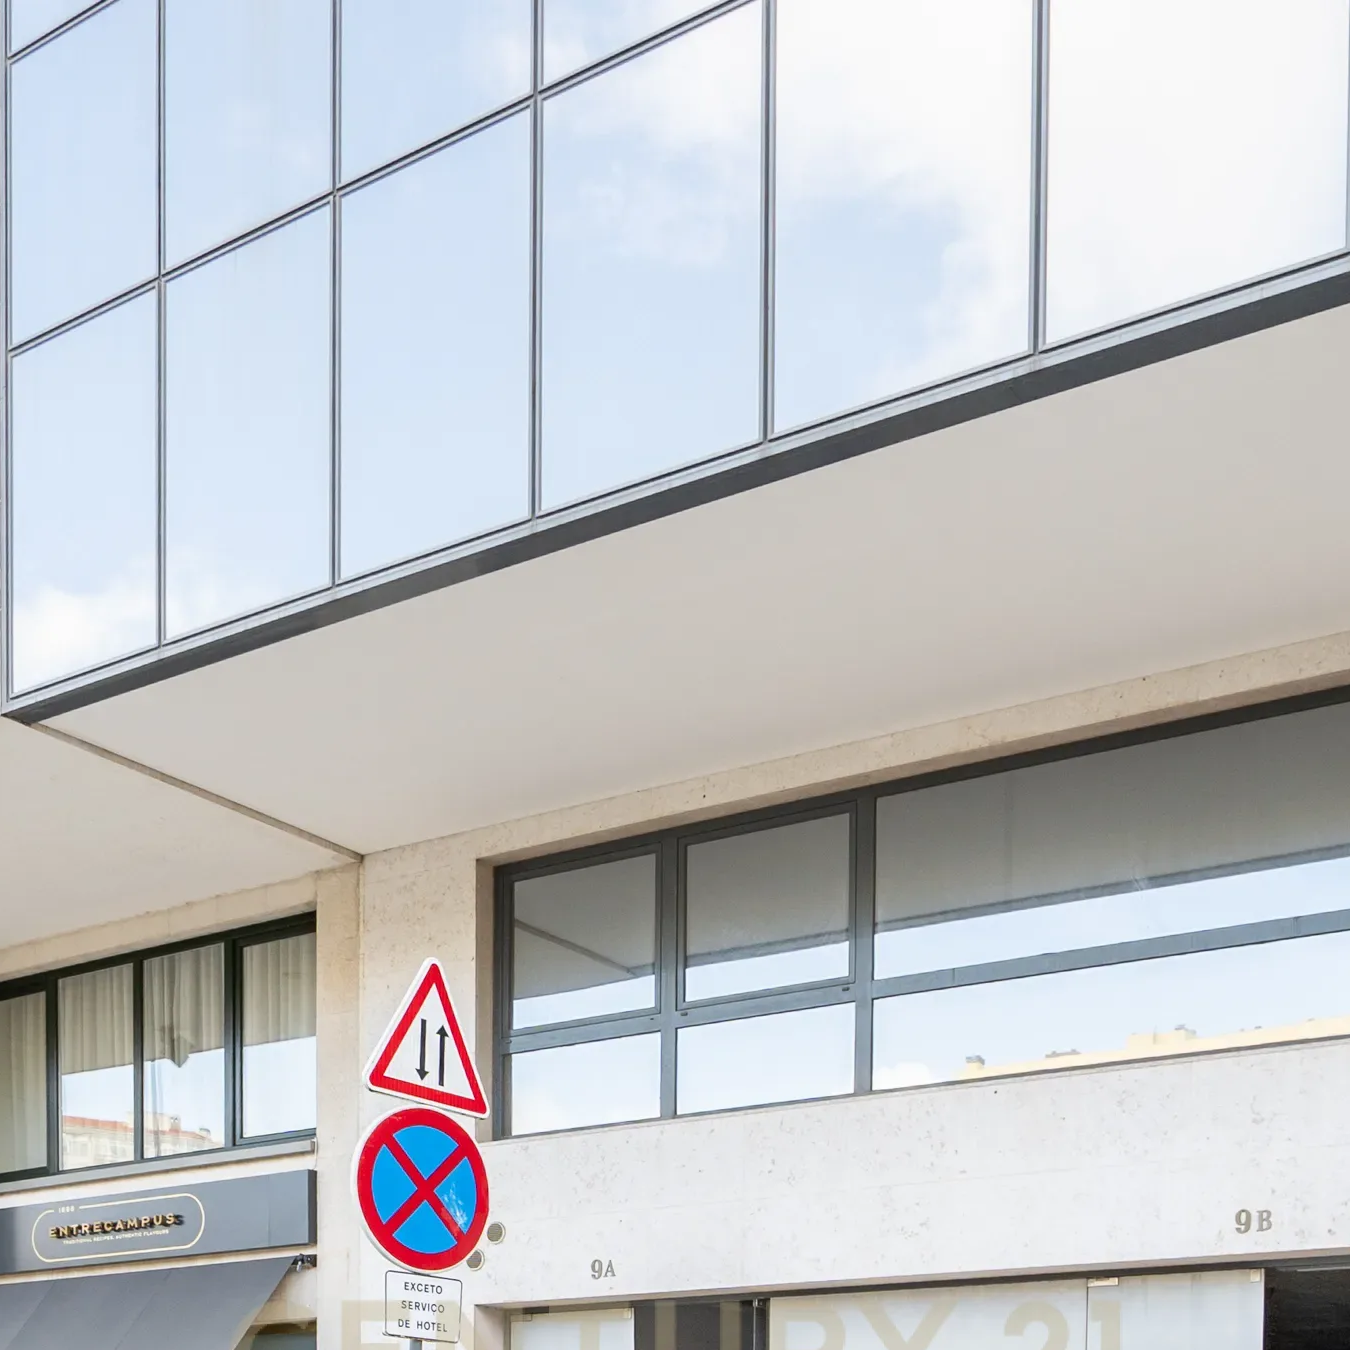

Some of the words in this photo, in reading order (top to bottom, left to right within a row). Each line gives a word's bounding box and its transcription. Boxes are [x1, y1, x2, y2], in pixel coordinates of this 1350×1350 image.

[48, 1212, 176, 1239] ENTRECAMPUS
[591, 1258, 617, 1280] 9A
[403, 1281, 443, 1295] EXCETO
[401, 1300, 445, 1315] SERVIÇO
[397, 1318, 410, 1329] DE
[416, 1320, 448, 1333] HOTEL
